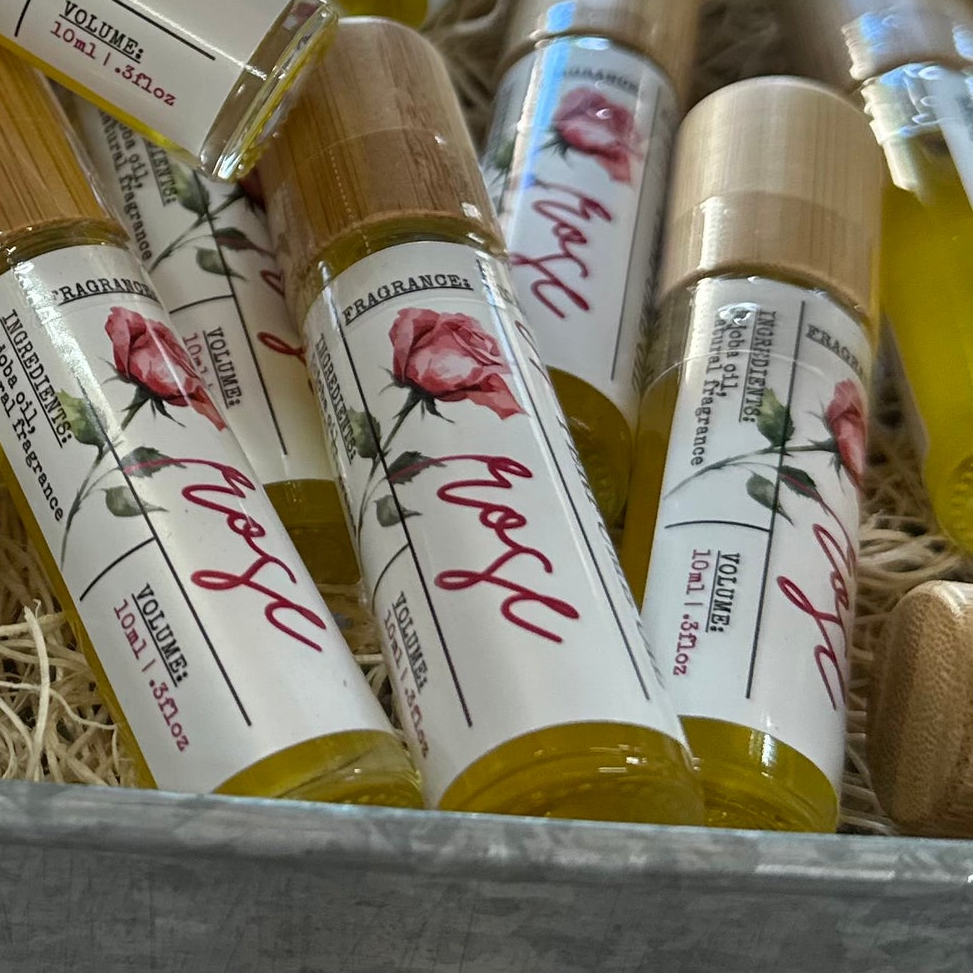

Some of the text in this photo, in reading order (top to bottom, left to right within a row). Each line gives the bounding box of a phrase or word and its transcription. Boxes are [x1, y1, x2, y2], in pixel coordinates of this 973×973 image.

[50, 20, 98, 62] 10ml
[114, 61, 177, 108] .3floz
[59, 0, 146, 64] VOLUME:
[123, 174, 153, 261] fragrance
[342, 273, 474, 326] FRAGRANCE:
[0, 309, 74, 449] INGREDIENTS:
[203, 327, 242, 409] VOLUME:
[738, 309, 777, 423] INGREDIENTS:
[15, 389, 38, 436] oil,
[690, 379, 720, 466] fragrance
[12, 417, 64, 522] fragrance
[686, 548, 712, 596] 10ml
[705, 550, 741, 633] VOLUME:
[114, 598, 149, 661] 10ml
[148, 678, 190, 753] .3floz
[131, 582, 189, 688] VOLUME:
[392, 590, 429, 694] VOLUME:
[673, 613, 700, 677] .3floz
